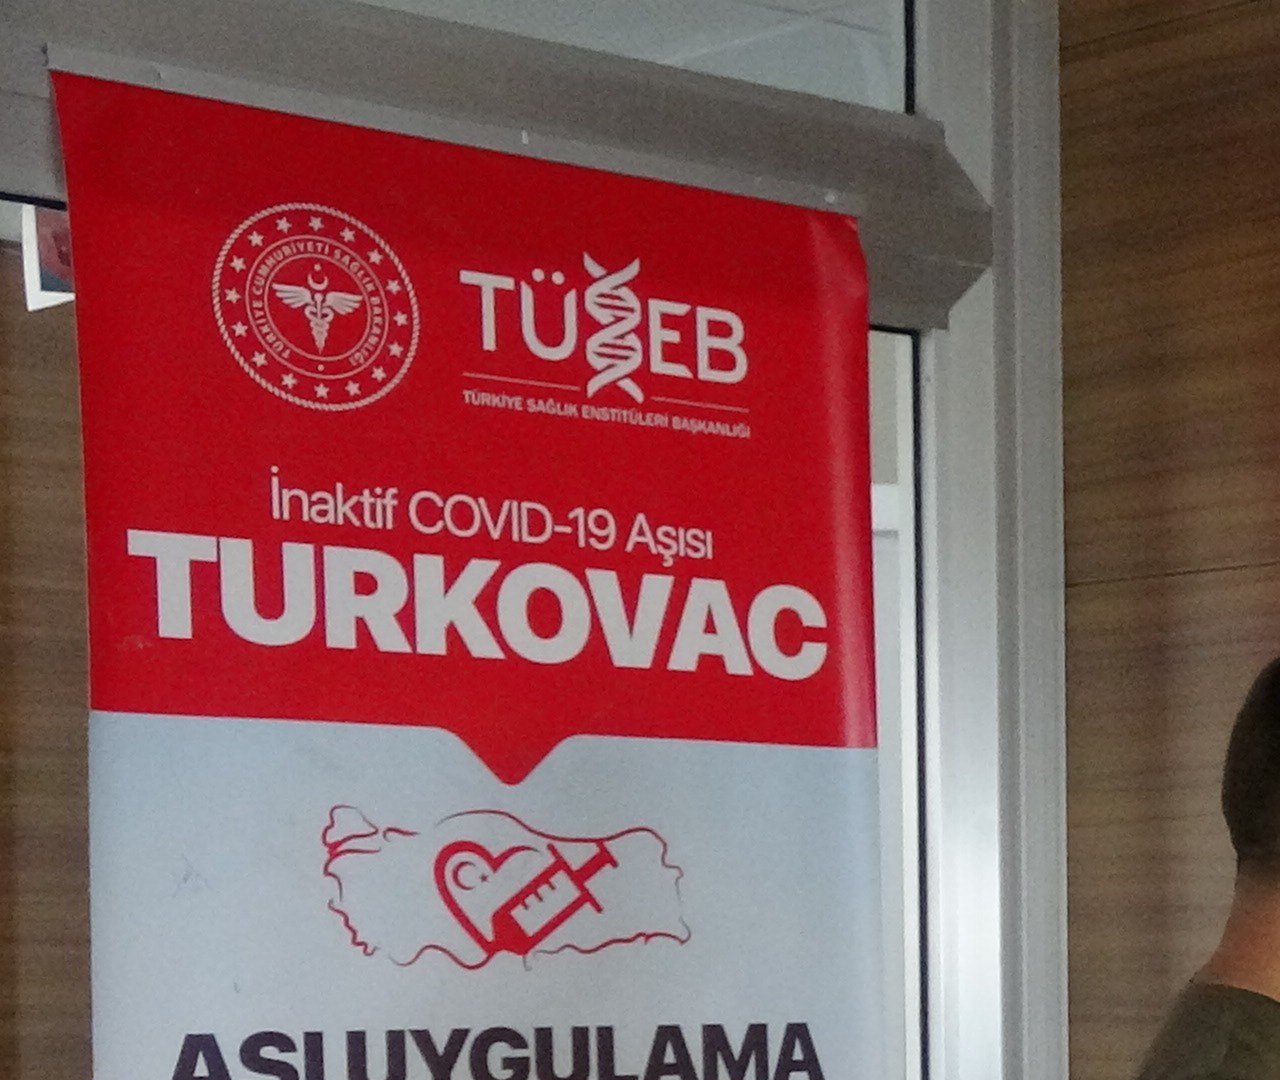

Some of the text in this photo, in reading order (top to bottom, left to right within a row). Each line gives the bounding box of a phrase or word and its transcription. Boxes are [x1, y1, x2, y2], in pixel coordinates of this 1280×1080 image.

[462, 389, 750, 439] TÜRKİYE SAĞLIK ENSTİTÜLERİ BAŞKANLIĞI
[270, 466, 713, 566] İnaktif COVID-19 Aşısı
[127, 529, 828, 682] TURKOVAC
